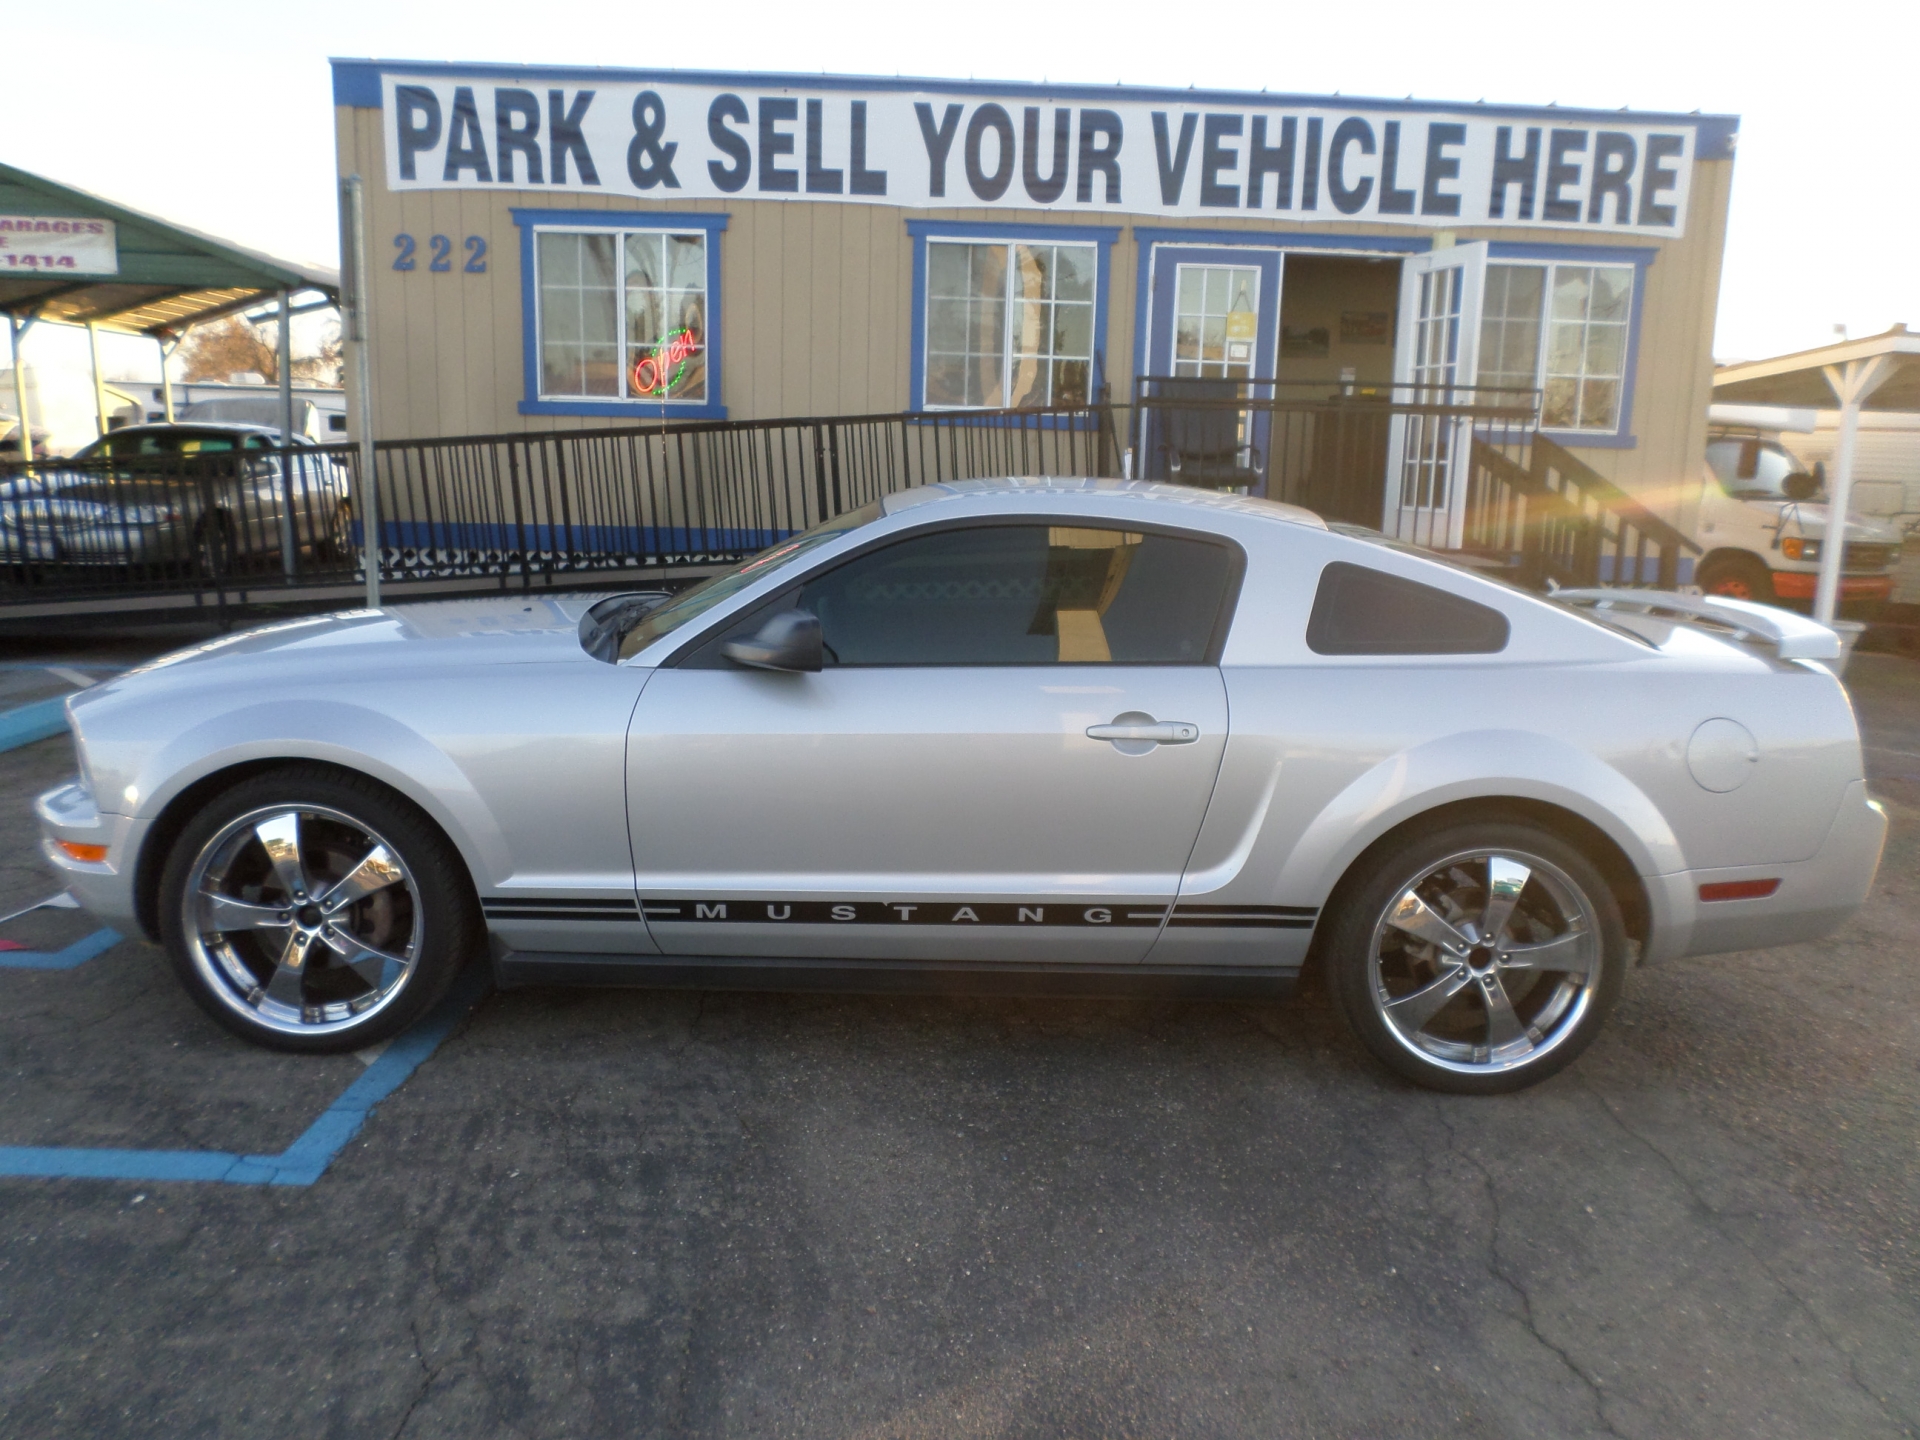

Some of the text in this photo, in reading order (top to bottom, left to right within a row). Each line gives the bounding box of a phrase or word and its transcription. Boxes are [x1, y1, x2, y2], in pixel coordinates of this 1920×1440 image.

[394, 84, 1686, 227] PARK & SELL YOUR VEHICLE HERE
[391, 232, 487, 273] 222
[634, 328, 696, 392] Open
[694, 902, 1113, 925] MUSTANG
